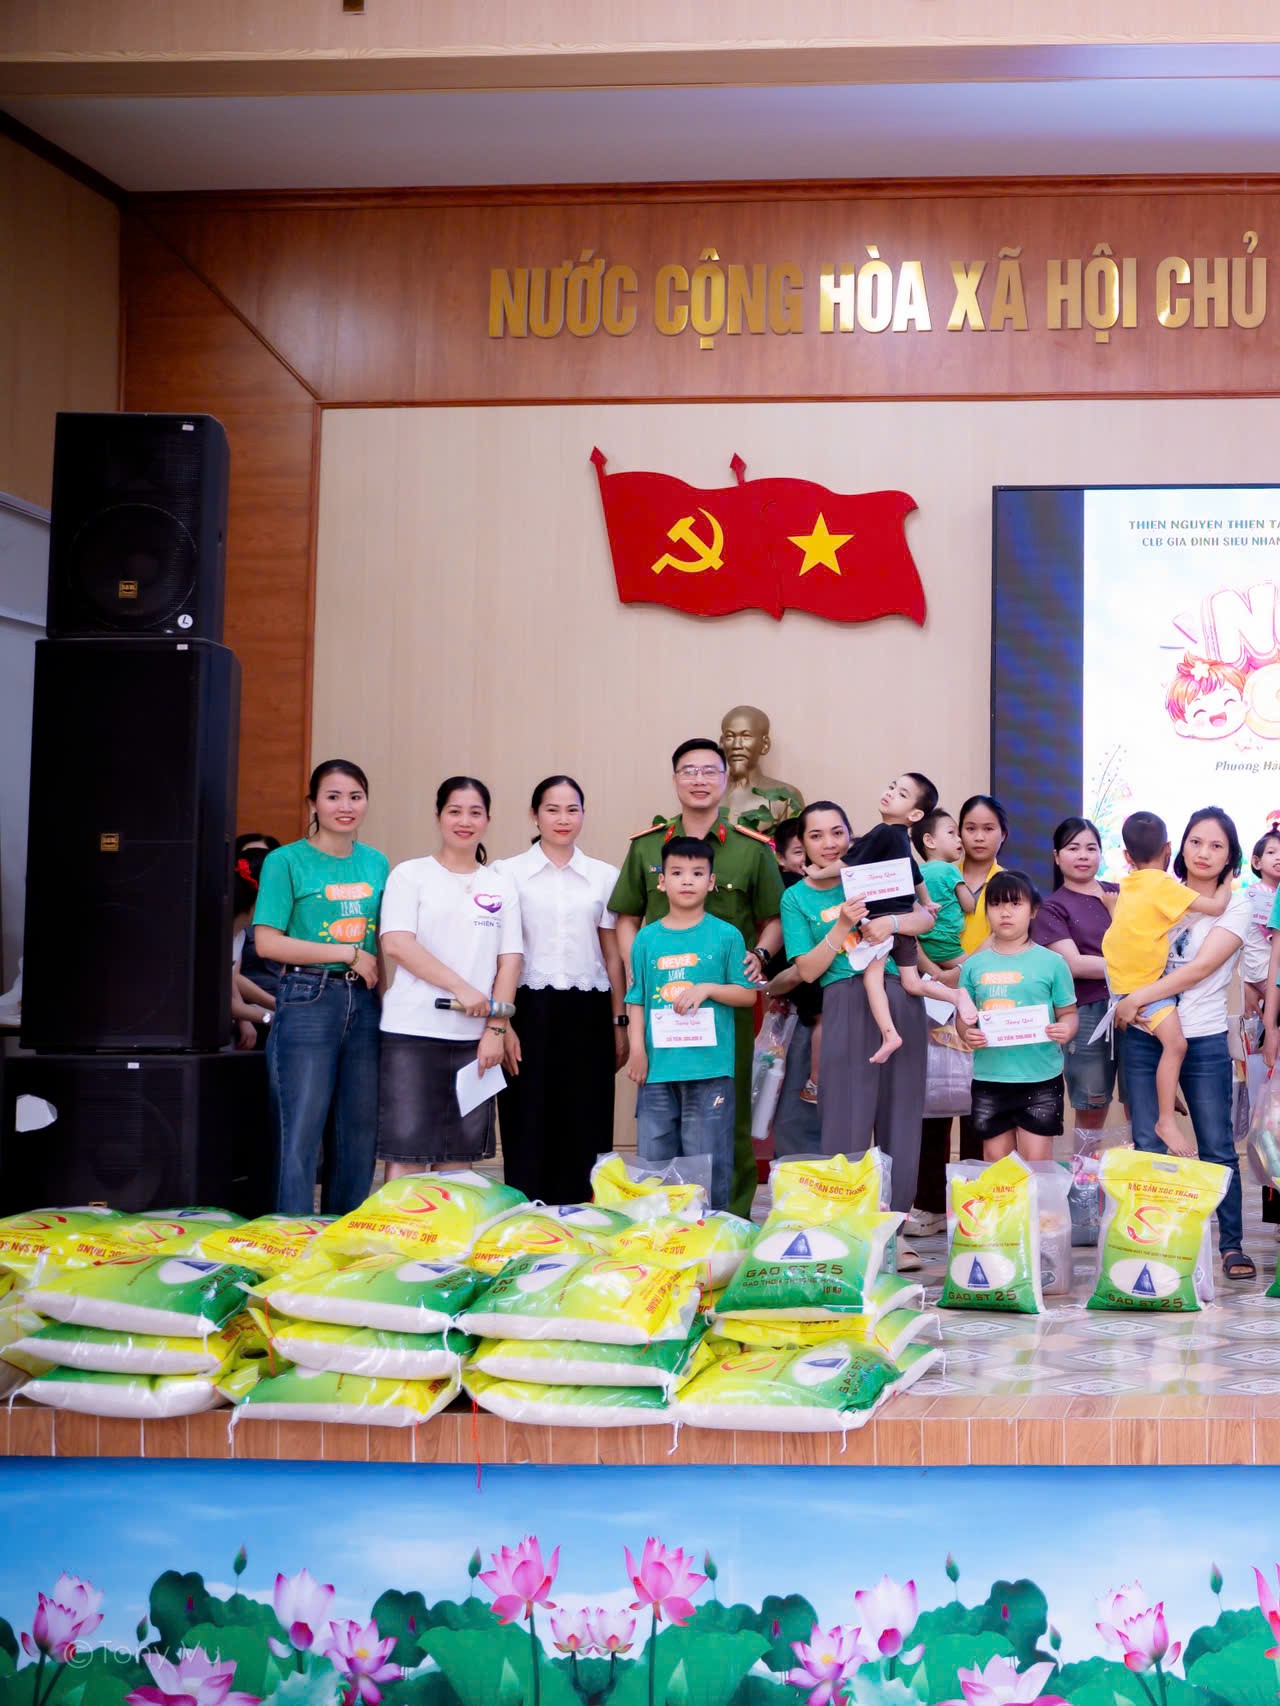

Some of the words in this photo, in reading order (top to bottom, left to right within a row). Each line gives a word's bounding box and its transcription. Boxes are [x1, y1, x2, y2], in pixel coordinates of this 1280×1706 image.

[489, 249, 638, 339] NƯỚC
[655, 247, 801, 350] CỘNG
[819, 245, 932, 333] HÒA
[947, 246, 1029, 332] XÃ
[1046, 242, 1138, 345] HỘI
[1155, 230, 1268, 329] CHỦ
[1142, 537, 1163, 547] CLB
[1167, 537, 1186, 546] GIA
[815, 1263, 844, 1276] 25
[976, 1293, 990, 1301] ST
[995, 1290, 1017, 1302] 25
[1140, 1300, 1157, 1308] ST
[1160, 1298, 1183, 1309] 25
